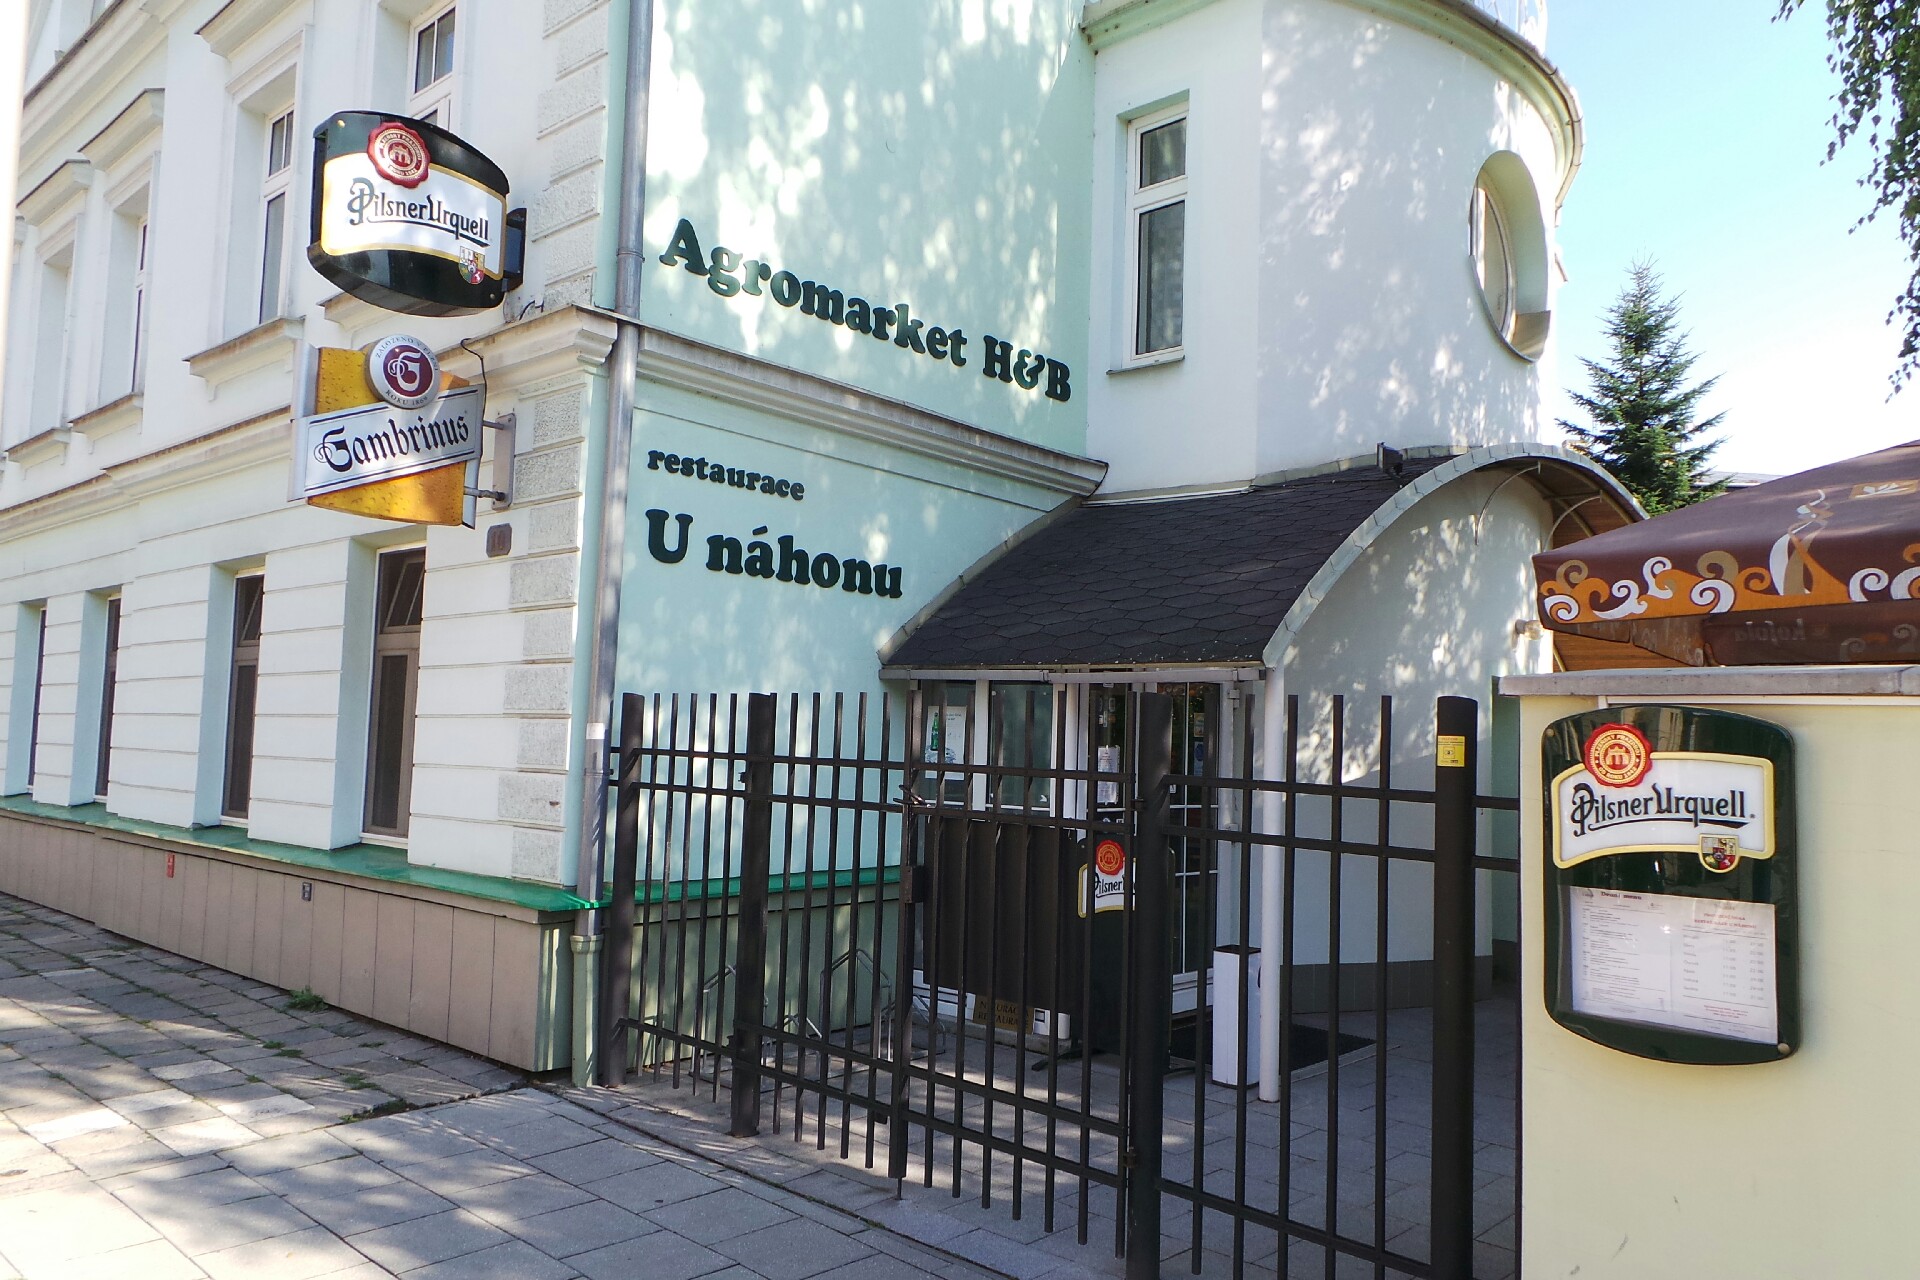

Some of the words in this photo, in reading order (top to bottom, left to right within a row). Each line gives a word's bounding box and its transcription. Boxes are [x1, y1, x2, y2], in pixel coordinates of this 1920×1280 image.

[347, 177, 427, 225] Pilsner
[427, 194, 489, 242] Urquell
[659, 218, 967, 366] Agromarket
[983, 335, 1071, 402] H&B
[314, 415, 469, 473] Gambrinus
[647, 449, 805, 501] restaurace
[645, 508, 694, 564] U
[705, 525, 903, 599] náhonu
[1571, 783, 1653, 837] Pilsner
[1652, 783, 1745, 828] Urquell
